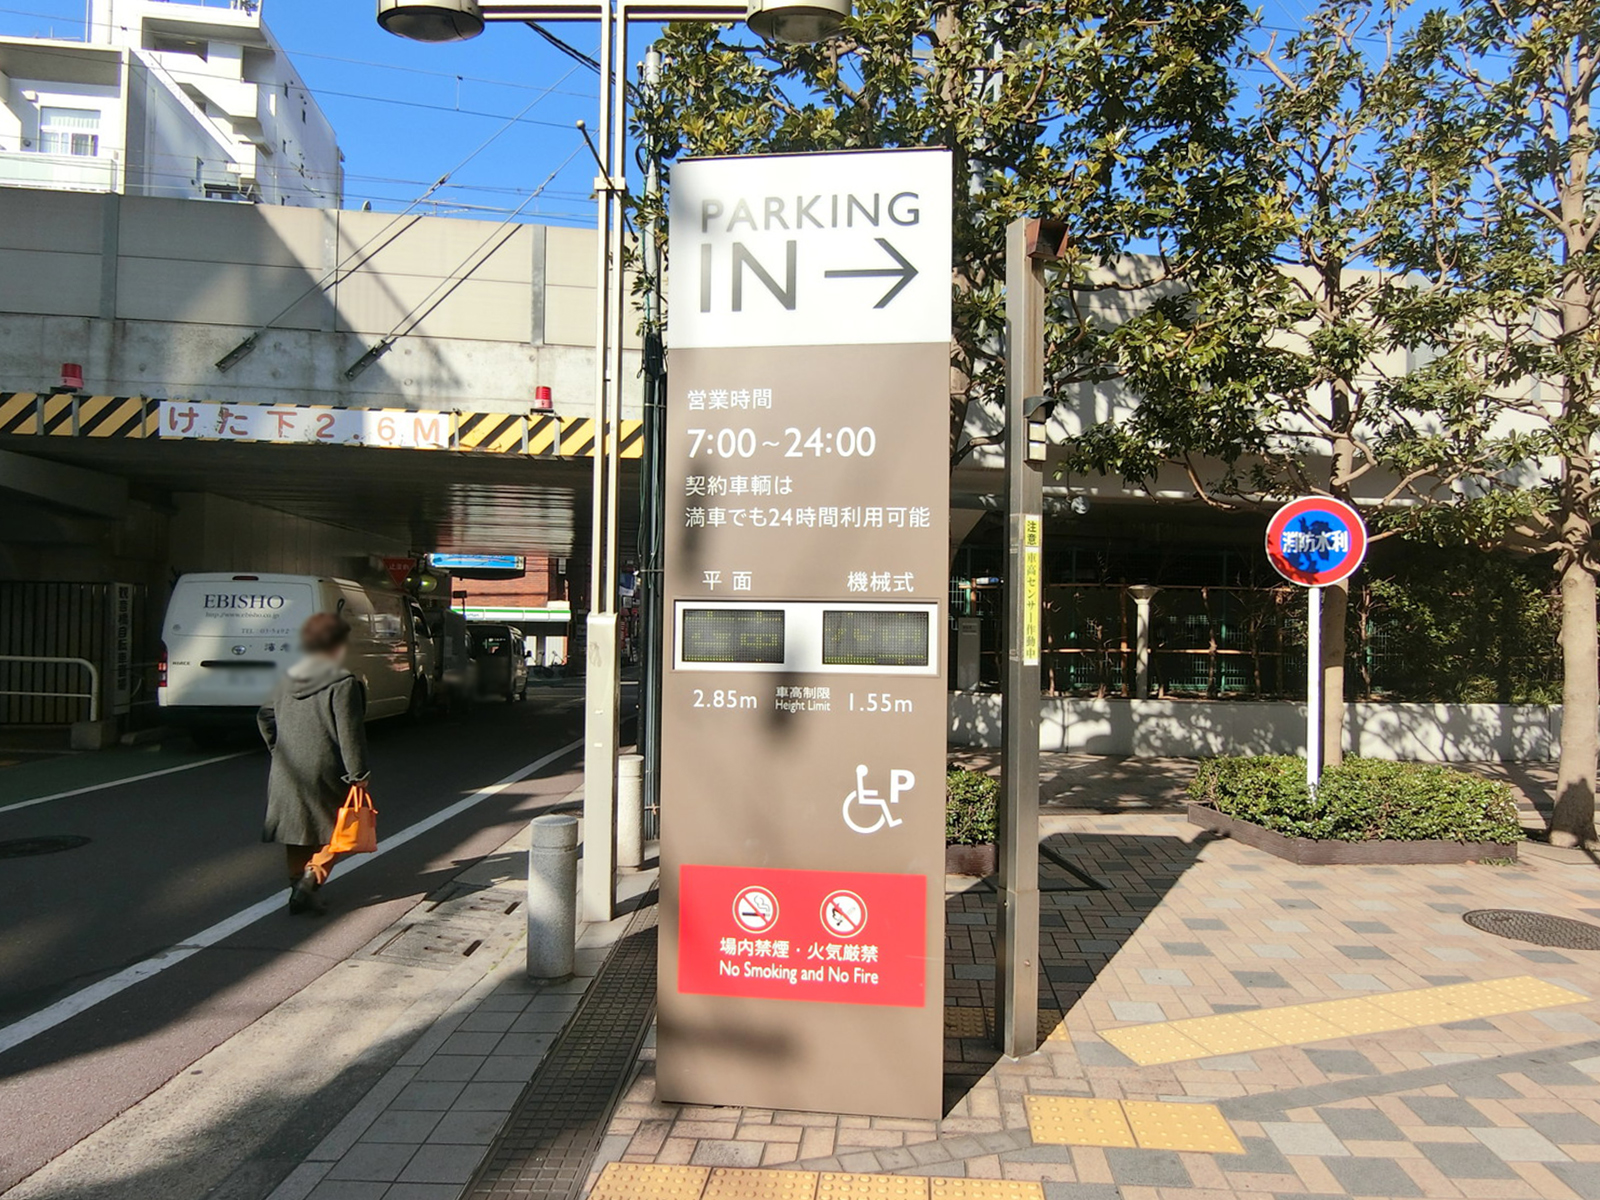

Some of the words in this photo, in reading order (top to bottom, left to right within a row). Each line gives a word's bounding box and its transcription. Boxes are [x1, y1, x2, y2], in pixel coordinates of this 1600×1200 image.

[701, 191, 920, 234] PARKING
[700, 239, 797, 313] IN
[687, 389, 773, 411] 営業時間
[684, 505, 931, 529] 満車でも24時間利用可能
[1026, 519, 1038, 546] 注意
[1282, 530, 1349, 554] 消防水利
[846, 571, 915, 593] 機械式
[203, 594, 285, 609] EBISHO
[1025, 552, 1038, 660] 車高センサー作動中
[692, 688, 758, 709] 2.85m
[775, 686, 831, 700] 車高制限
[849, 692, 914, 713] 1.55m
[775, 699, 805, 713] Height
[808, 699, 831, 711] Limit
[890, 769, 916, 804] P
[719, 960, 740, 977] No
[743, 962, 797, 985] Smoking
[801, 967, 824, 982] and
[828, 967, 849, 983] No
[853, 968, 879, 984] Fire
